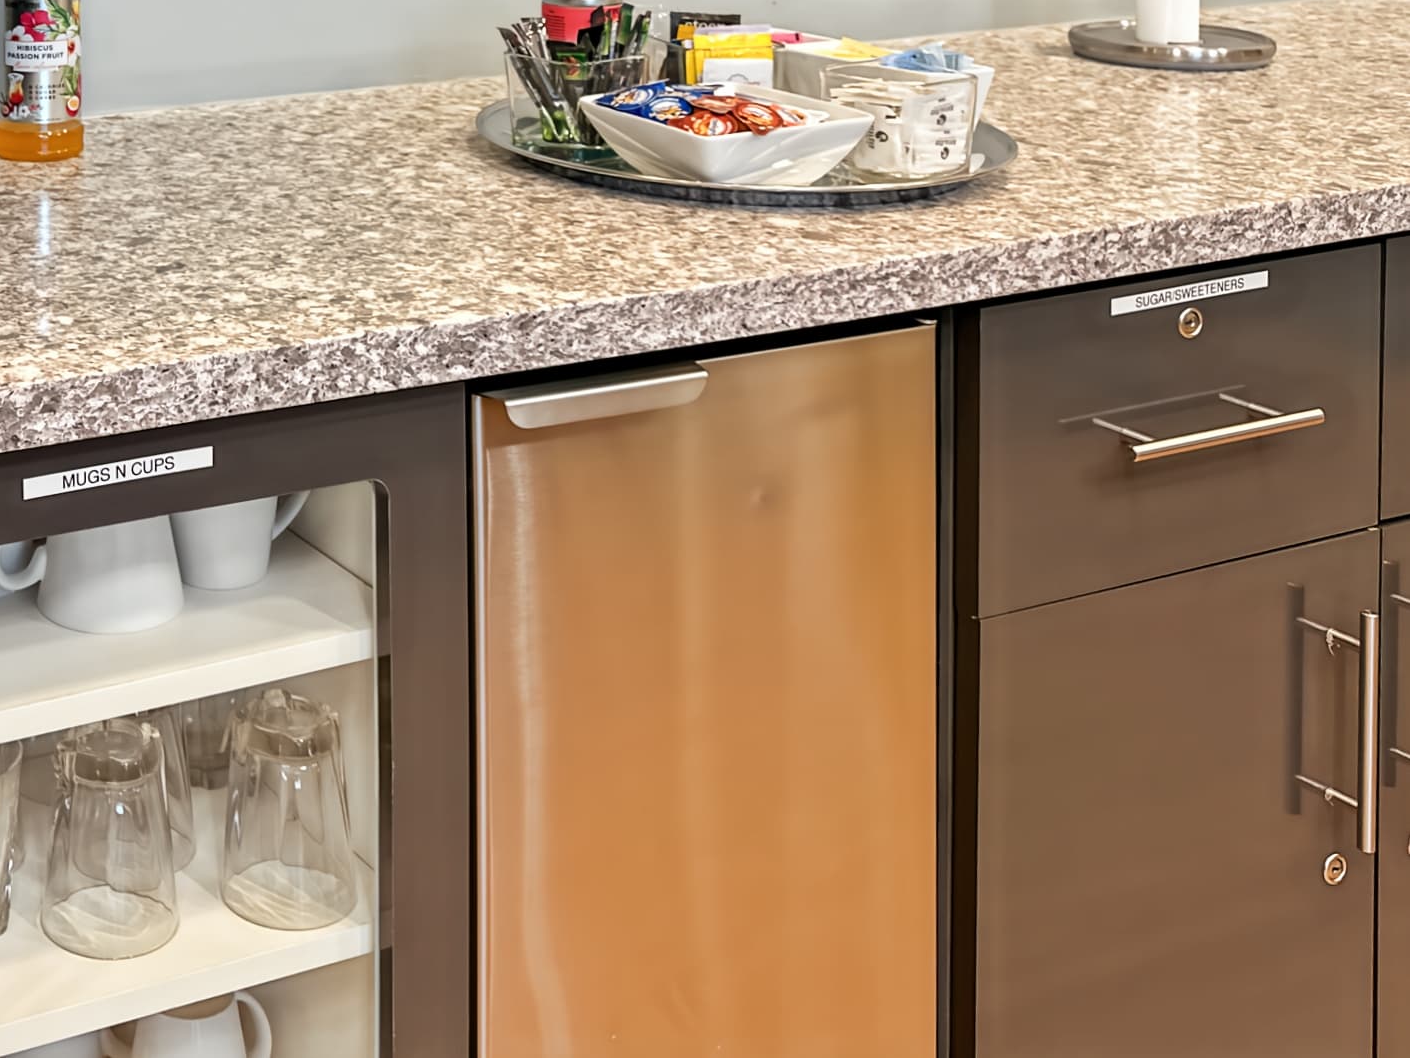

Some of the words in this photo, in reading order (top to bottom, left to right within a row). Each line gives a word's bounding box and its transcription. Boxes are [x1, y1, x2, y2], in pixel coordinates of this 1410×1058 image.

[7, 52, 39, 60] PASSION
[16, 44, 53, 52] HIBISCUS
[1135, 277, 1245, 309] SUGAR/SWEETENERS
[62, 467, 111, 489] MUGS
[115, 464, 127, 480] N
[130, 455, 176, 477] CUPS
